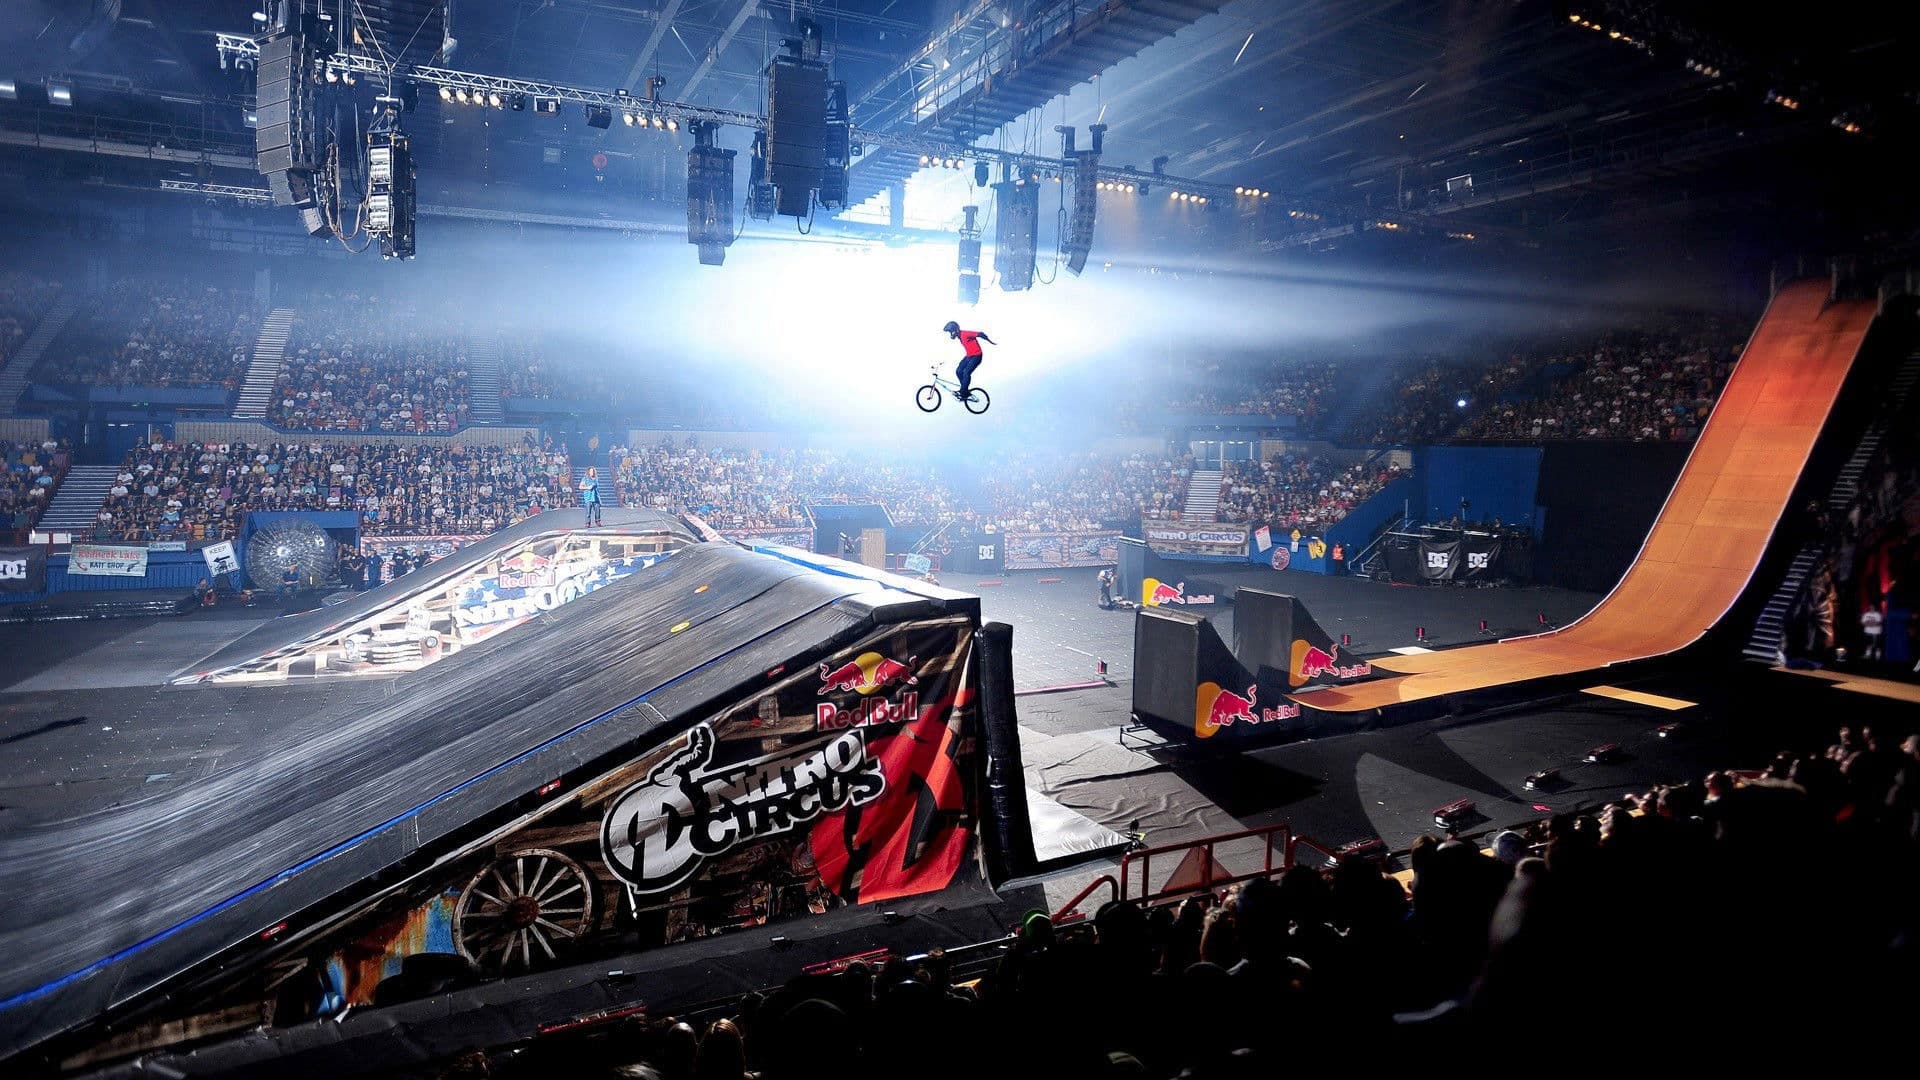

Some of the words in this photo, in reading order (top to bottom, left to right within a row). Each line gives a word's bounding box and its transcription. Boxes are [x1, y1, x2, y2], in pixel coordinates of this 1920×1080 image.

[1200, 531, 1244, 542] CIRCUS
[107, 561, 125, 569] SHOP
[1428, 552, 1449, 568] DC
[1468, 552, 1488, 568] DC
[702, 731, 863, 812] NITRO
[690, 757, 885, 854] CIRCUS
